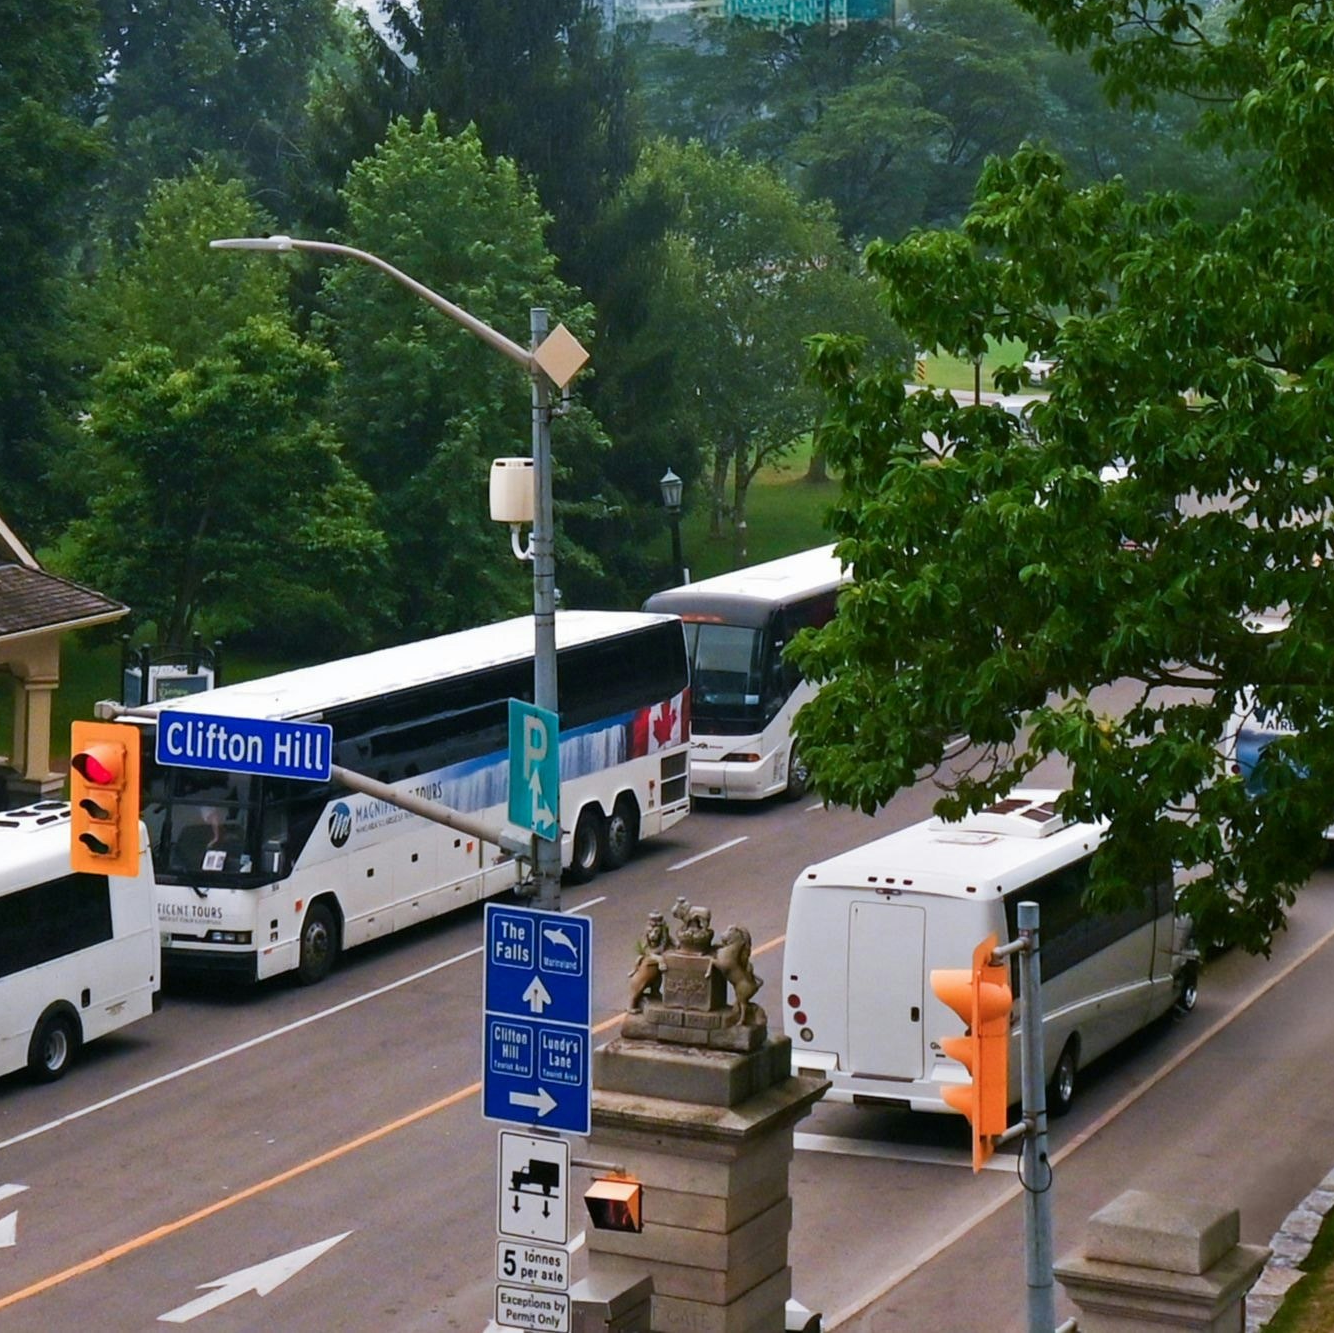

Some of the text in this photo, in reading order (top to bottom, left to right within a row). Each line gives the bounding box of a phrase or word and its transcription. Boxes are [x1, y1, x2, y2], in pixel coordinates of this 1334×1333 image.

[167, 720, 323, 770] Clifton Hill
[523, 713, 548, 780] P
[415, 780, 443, 801] TOURS
[192, 906, 223, 920] TOURS
[500, 920, 525, 941] The
[495, 941, 529, 962] Falls
[494, 1026, 528, 1045] Clifton
[542, 1033, 579, 1055] Lundy's
[502, 1043, 519, 1059] Hill
[549, 1051, 572, 1069] Lane
[515, 1063, 529, 1074] Area
[564, 1071, 578, 1082] Area
[503, 1249, 517, 1277] 5
[524, 1250, 561, 1268] tonnes
[520, 1267, 564, 1283] per axle
[500, 1292, 566, 1315] Exceptions by
[506, 1308, 560, 1329] Permit Only
